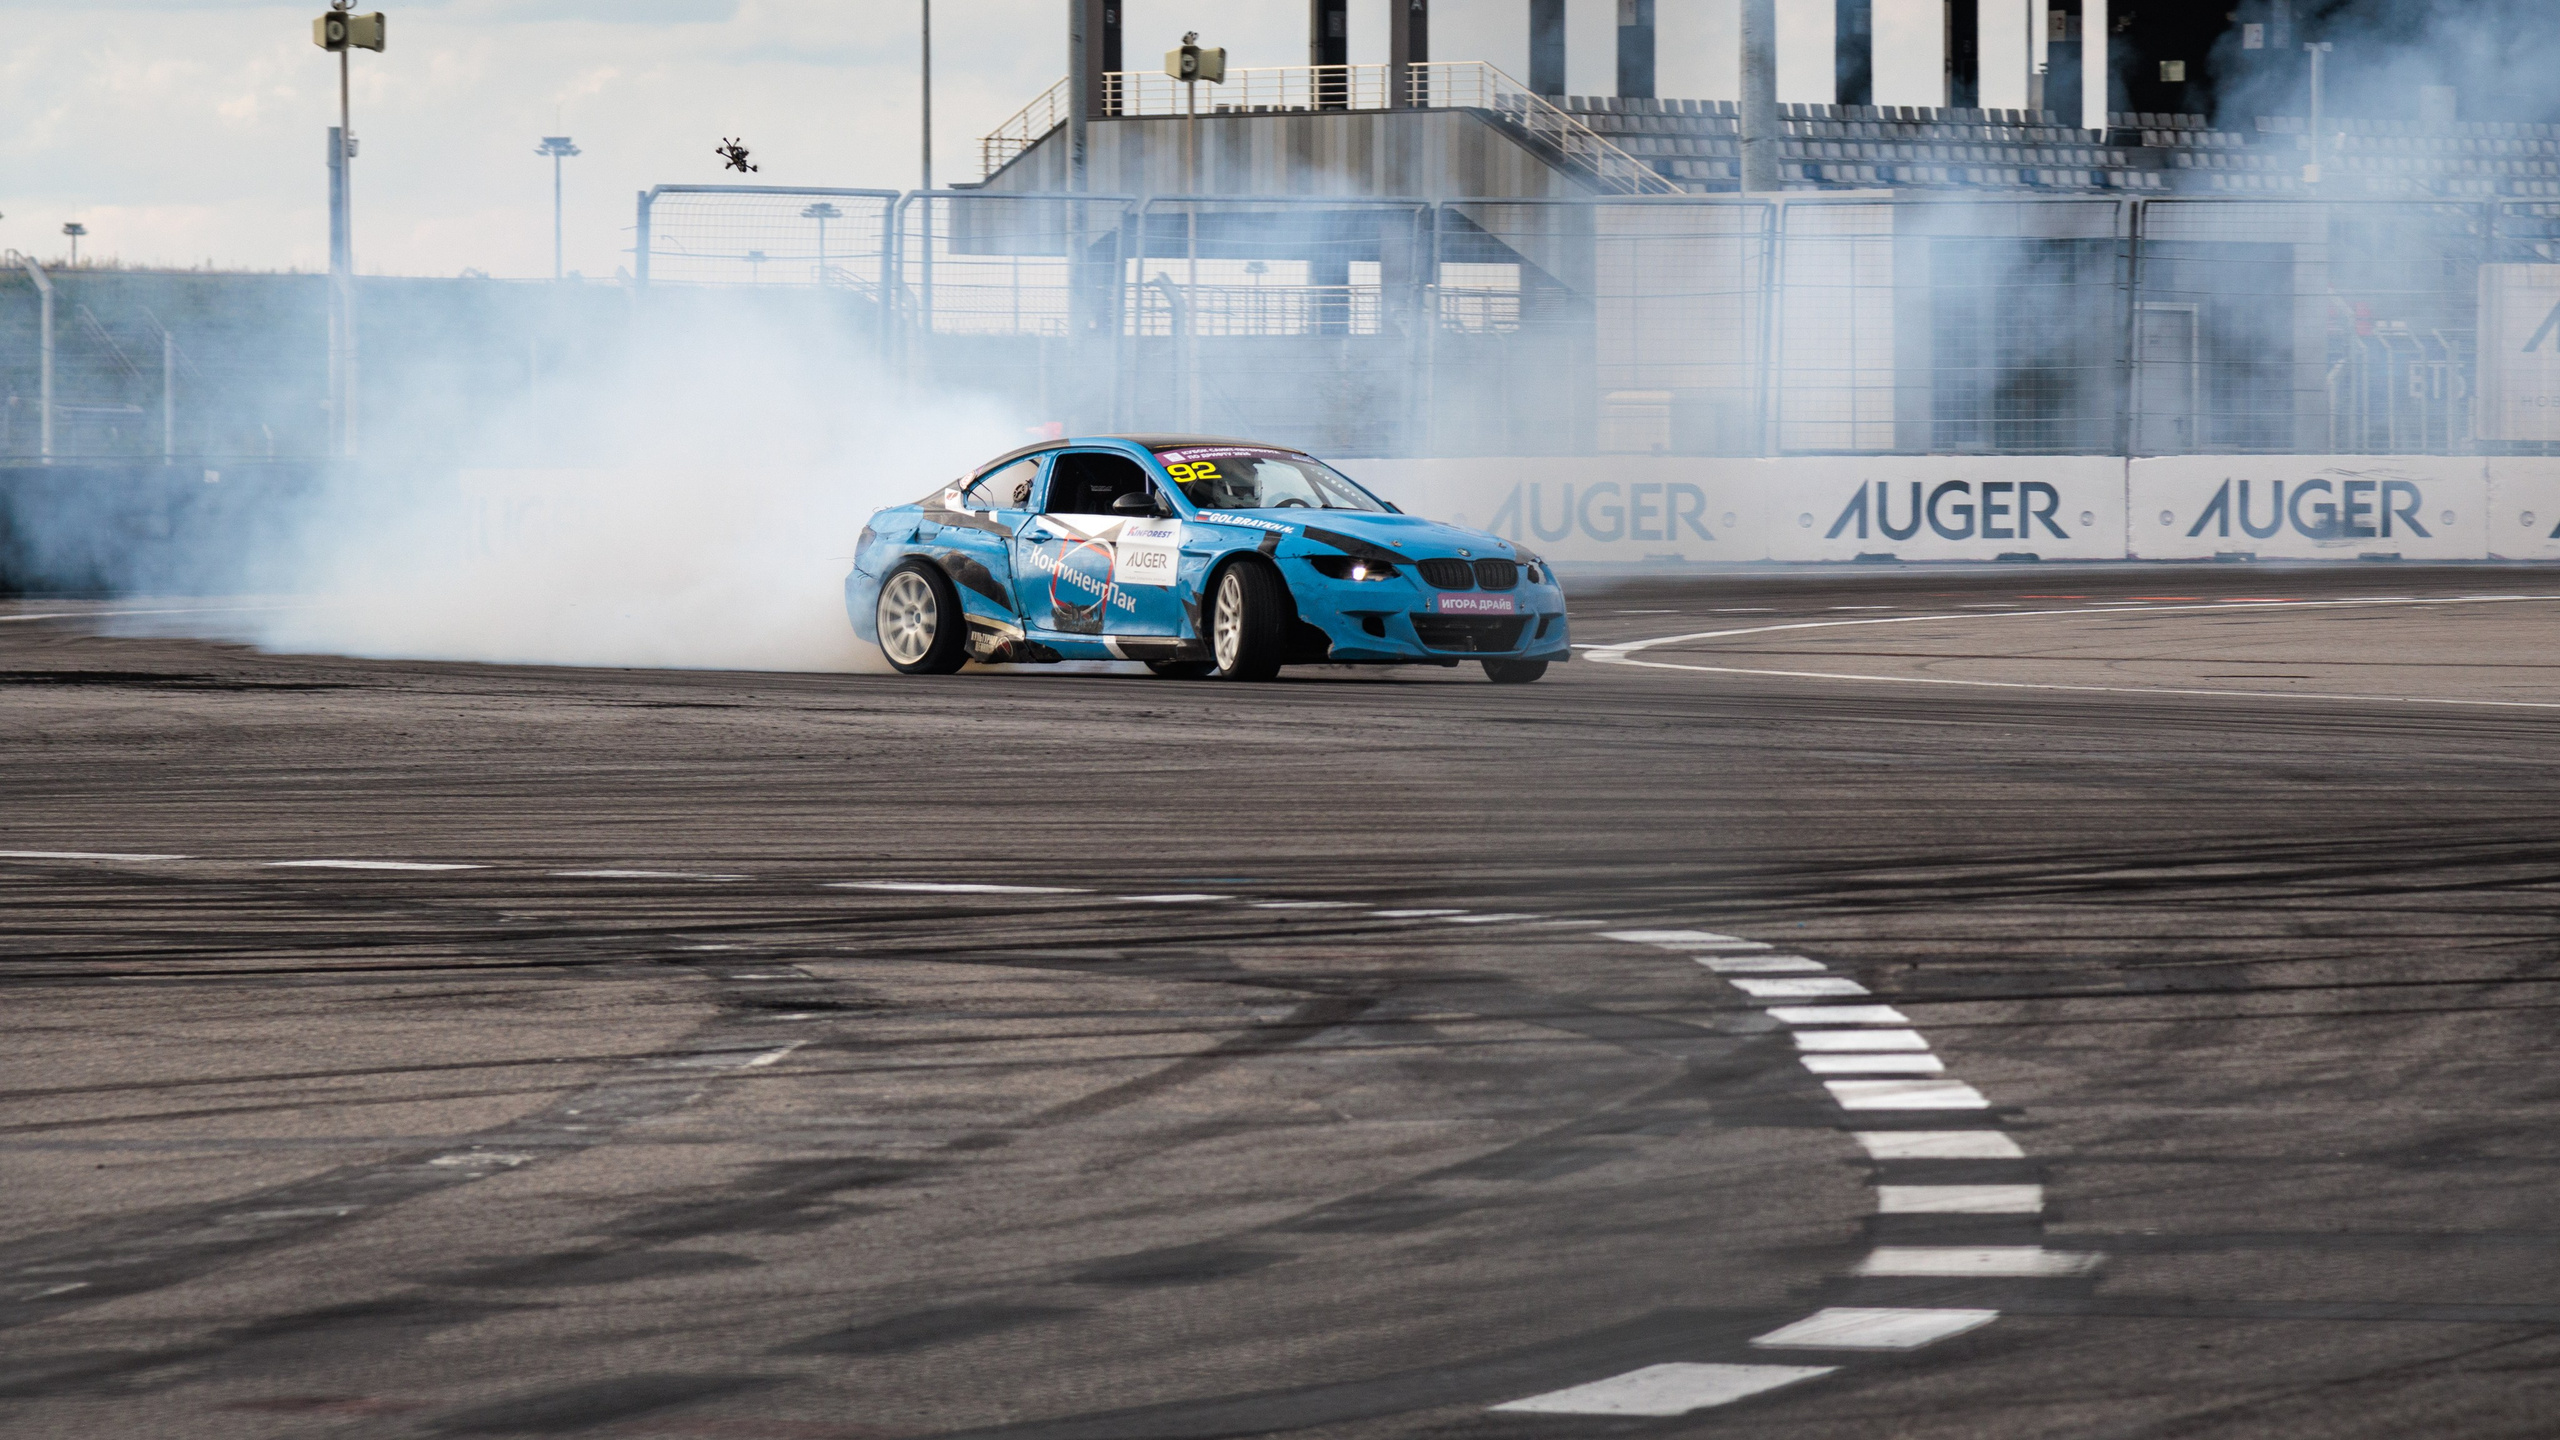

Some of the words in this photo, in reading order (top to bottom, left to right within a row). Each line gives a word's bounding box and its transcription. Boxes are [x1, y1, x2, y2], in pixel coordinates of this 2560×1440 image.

[1166, 461, 1222, 483] 92
[1209, 512, 1283, 532] GOLBRAYKH
[1486, 479, 1718, 542] AUGER
[1824, 478, 2071, 541] AUGER
[2186, 477, 2433, 539] AUGER
[1029, 544, 1138, 614] КонтинентПак
[1126, 551, 1168, 569] AUGER
[1441, 599, 1478, 609] ИГОРА
[1479, 598, 1512, 611] ДРАЙВ
